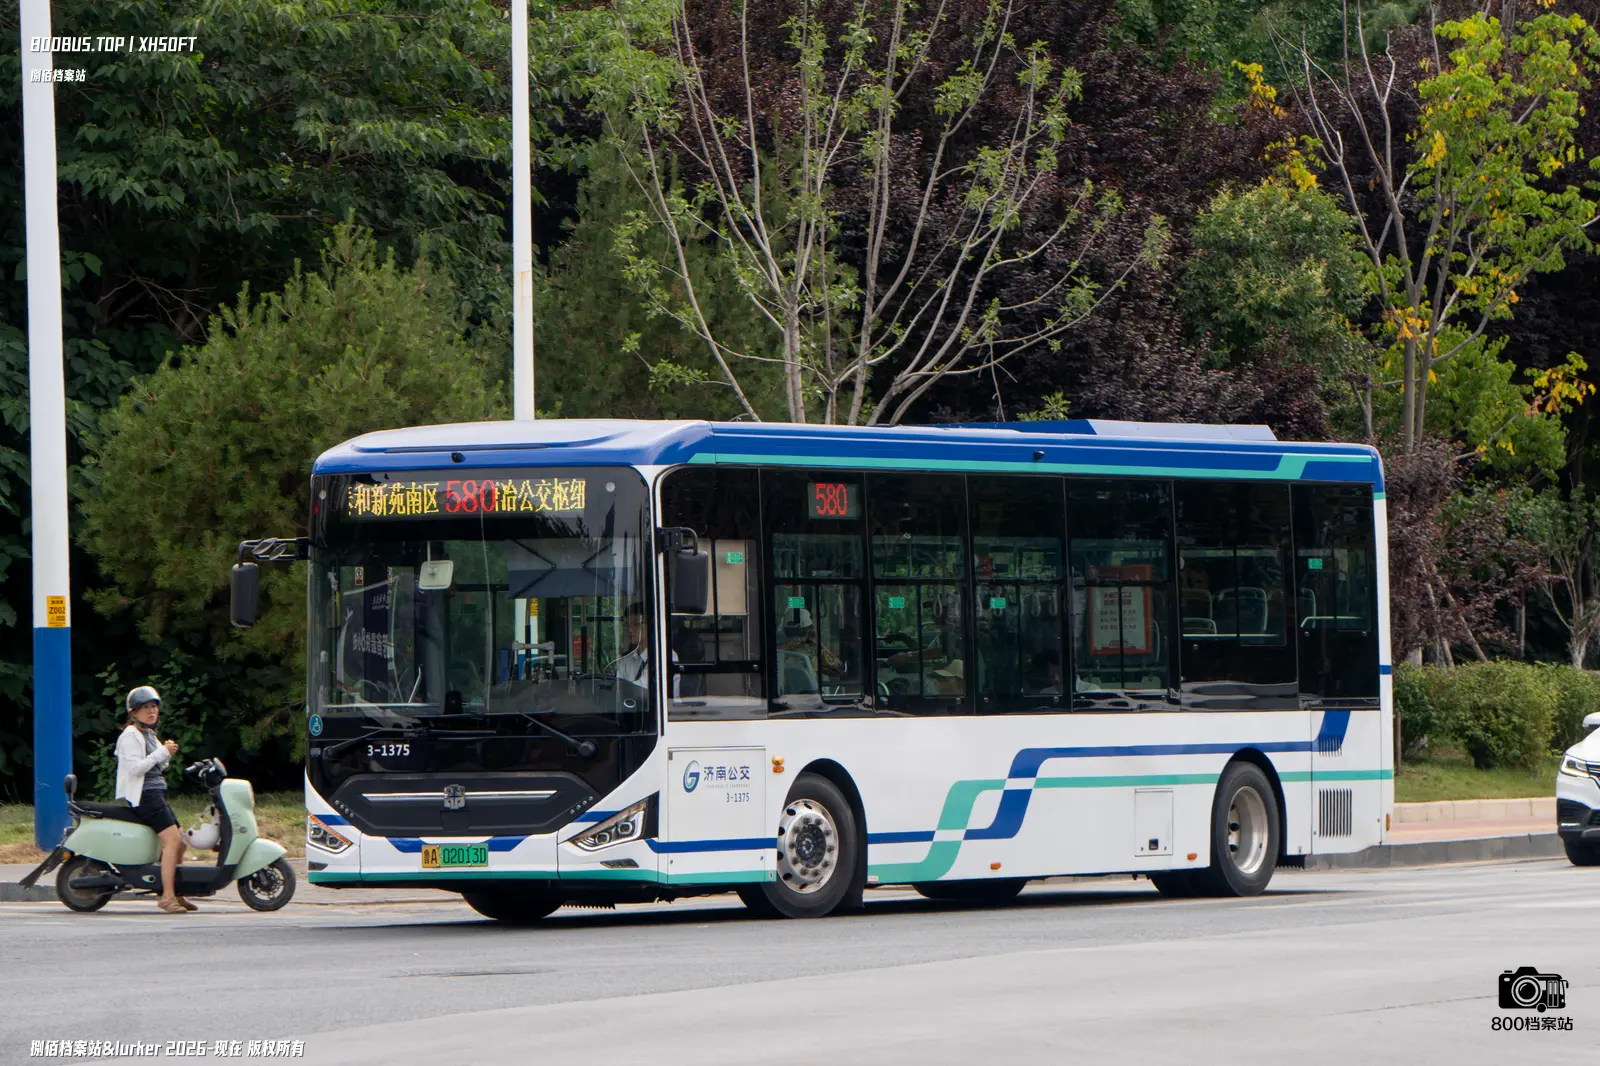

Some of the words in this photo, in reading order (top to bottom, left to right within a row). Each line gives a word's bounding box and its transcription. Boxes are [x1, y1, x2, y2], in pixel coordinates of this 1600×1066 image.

[445, 479, 496, 513] 580
[815, 483, 847, 515] 580
[367, 744, 410, 756] 3-1375
[704, 765, 750, 781] 济南公交
[726, 792, 750, 802] 3-1375
